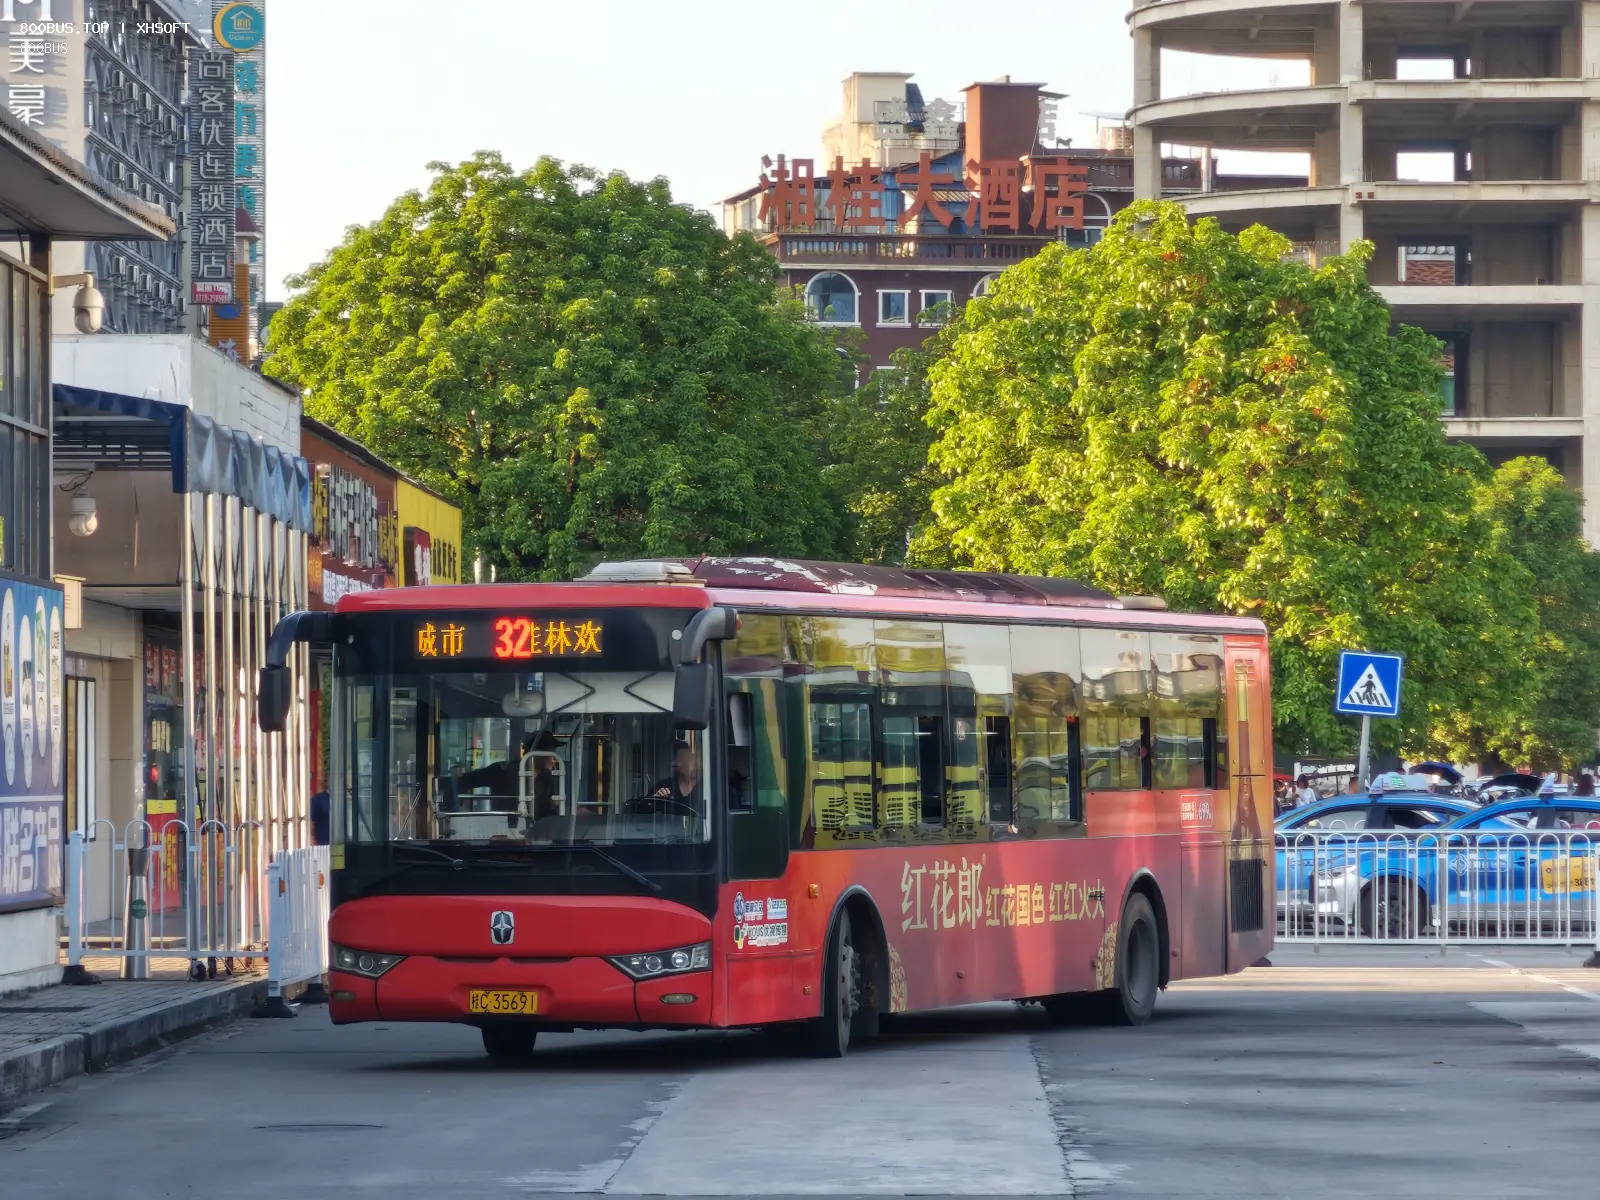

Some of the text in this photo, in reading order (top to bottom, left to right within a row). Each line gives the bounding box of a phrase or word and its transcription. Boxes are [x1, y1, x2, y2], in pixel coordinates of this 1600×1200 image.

[198, 51, 227, 279] 尚客优连锁酒店
[758, 152, 1090, 231] 湘桂大酒店
[494, 617, 533, 659] 32
[900, 856, 984, 935] 红花郎
[985, 878, 1106, 928] 红花国色 红红火火
